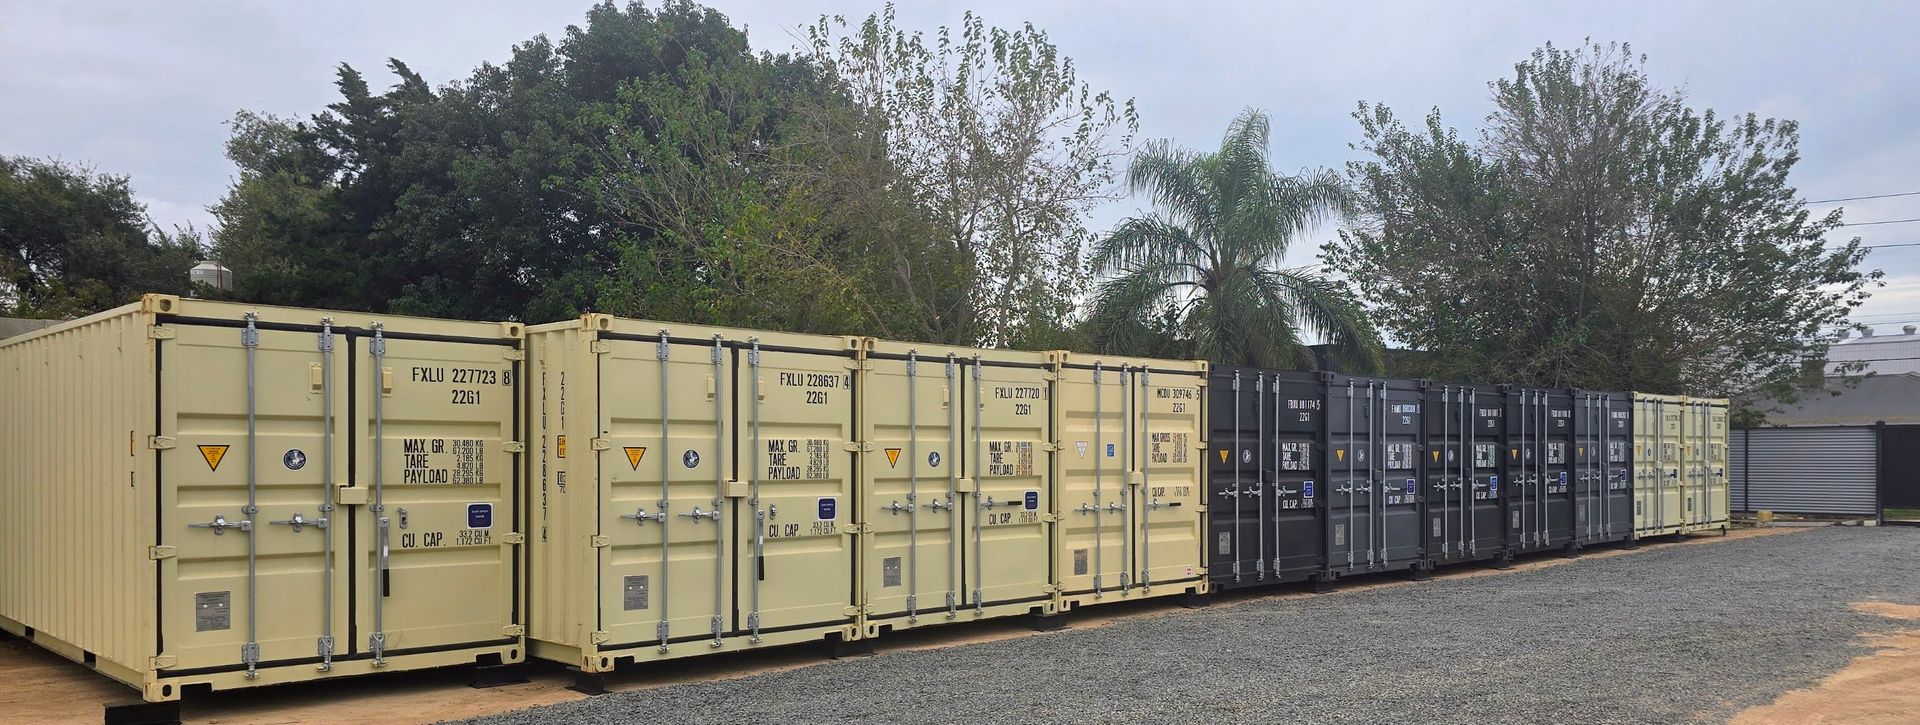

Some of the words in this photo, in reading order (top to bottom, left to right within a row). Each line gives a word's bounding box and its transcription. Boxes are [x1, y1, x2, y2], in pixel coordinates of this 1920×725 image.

[412, 367, 444, 383] FXLU
[452, 368, 496, 384] 227723
[503, 371, 511, 385] 8
[780, 372, 803, 386] FXLU
[807, 374, 839, 388] 228637
[452, 389, 480, 404] 22G1
[806, 391, 828, 404] 22G1
[995, 387, 1012, 398] FXLU
[1015, 387, 1039, 399] 227720
[1173, 388, 1191, 399] 309746
[1016, 404, 1031, 415] 22G1
[404, 439, 428, 453] MAX.
[432, 439, 448, 453] GR.
[768, 440, 786, 452] MAX.
[788, 440, 800, 453] GR.
[404, 454, 428, 468] TARE
[769, 453, 786, 466] TARE
[990, 453, 1003, 463] TARE
[768, 467, 800, 479] PAYLOAD
[989, 464, 1013, 475] PAYLOAD
[404, 469, 447, 484] PAYLOAD
[769, 524, 780, 537] CU.
[785, 524, 801, 537] CAP.
[402, 533, 418, 548] CU.
[424, 532, 446, 546] CAP.
